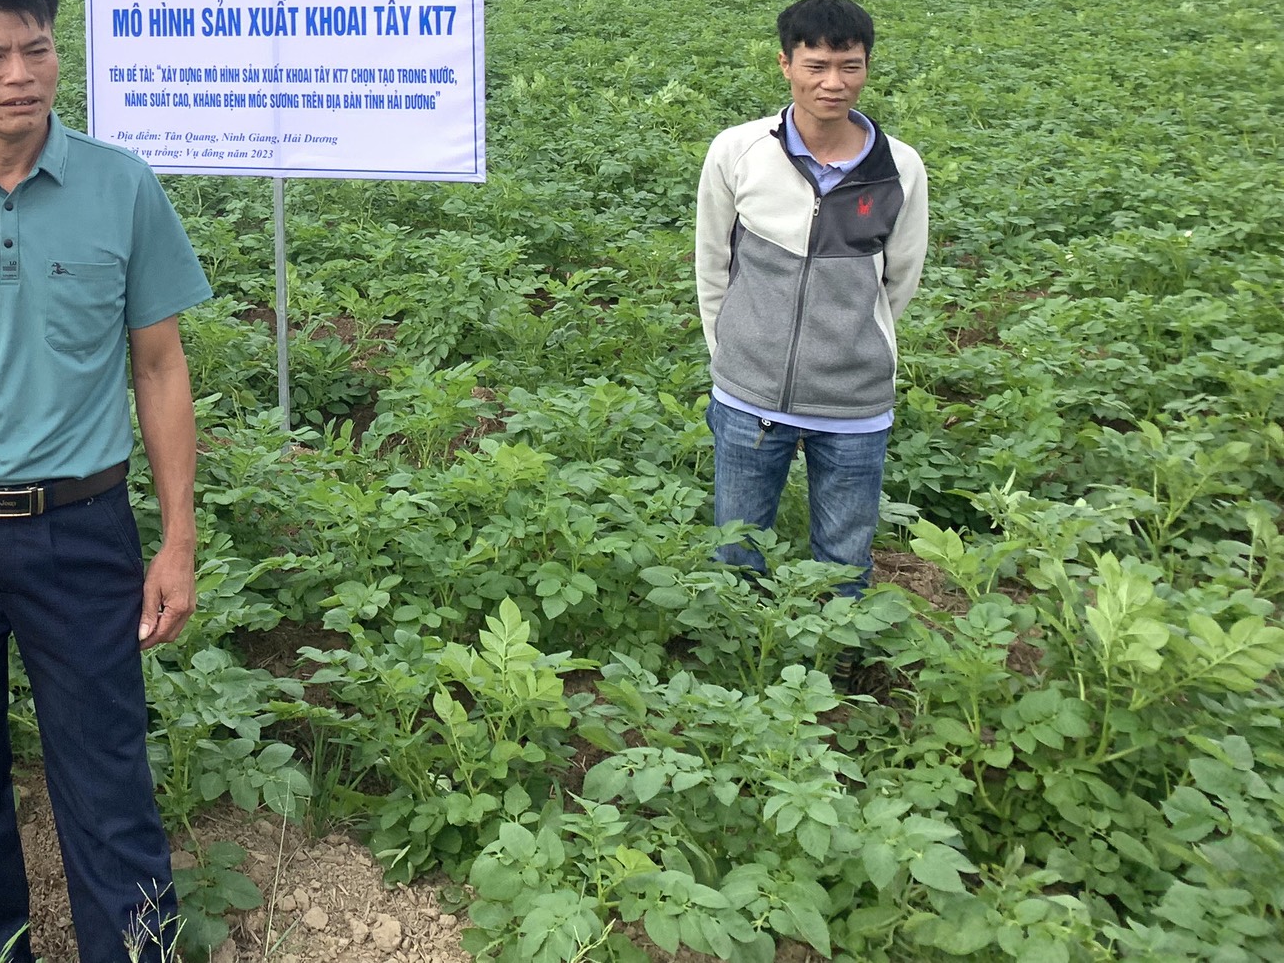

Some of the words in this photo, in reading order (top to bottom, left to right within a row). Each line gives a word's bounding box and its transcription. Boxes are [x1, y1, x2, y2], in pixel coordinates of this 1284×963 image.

[112, 2, 143, 37] MÔ
[148, 2, 196, 37] HÌNH
[305, 6, 367, 36] KHOAI
[372, 0, 412, 36] TÂY
[418, 5, 457, 35] KT7
[108, 65, 125, 82] TÊN
[126, 64, 138, 82] ĐỀ
[138, 65, 155, 82] TÀI:
[179, 67, 203, 85] DỰNG
[203, 65, 218, 82] MÔ
[219, 65, 241, 82] HÌNH
[241, 63, 260, 83] SẢN
[261, 63, 284, 83] XUẤT
[285, 68, 313, 83] KHOAI
[313, 65, 331, 83] TÂY
[332, 68, 349, 83] KT7
[350, 68, 376, 86] CHỌN
[377, 68, 395, 86] TẠO
[396, 69, 428, 83] TRONG
[428, 66, 458, 85] NƯỚC,
[124, 90, 148, 107] NĂNG
[149, 88, 171, 107] SUẤT
[172, 93, 192, 109] CAO,
[192, 90, 222, 107] KHÁNG
[223, 90, 247, 111] BỆNH
[247, 89, 268, 108] MỐC
[269, 93, 300, 108] SƯƠNG
[300, 91, 324, 109] TRÊN
[325, 94, 342, 112] ĐỊA
[343, 91, 363, 109] BÀN
[363, 90, 385, 109] TỈNH
[386, 90, 403, 109] HẢI
[117, 131, 134, 142] Địa
[164, 132, 183, 141] Tân
[184, 132, 219, 143] Quang,
[221, 133, 246, 141] Ninh
[248, 133, 280, 144] Giang,
[303, 134, 338, 145] Dương
